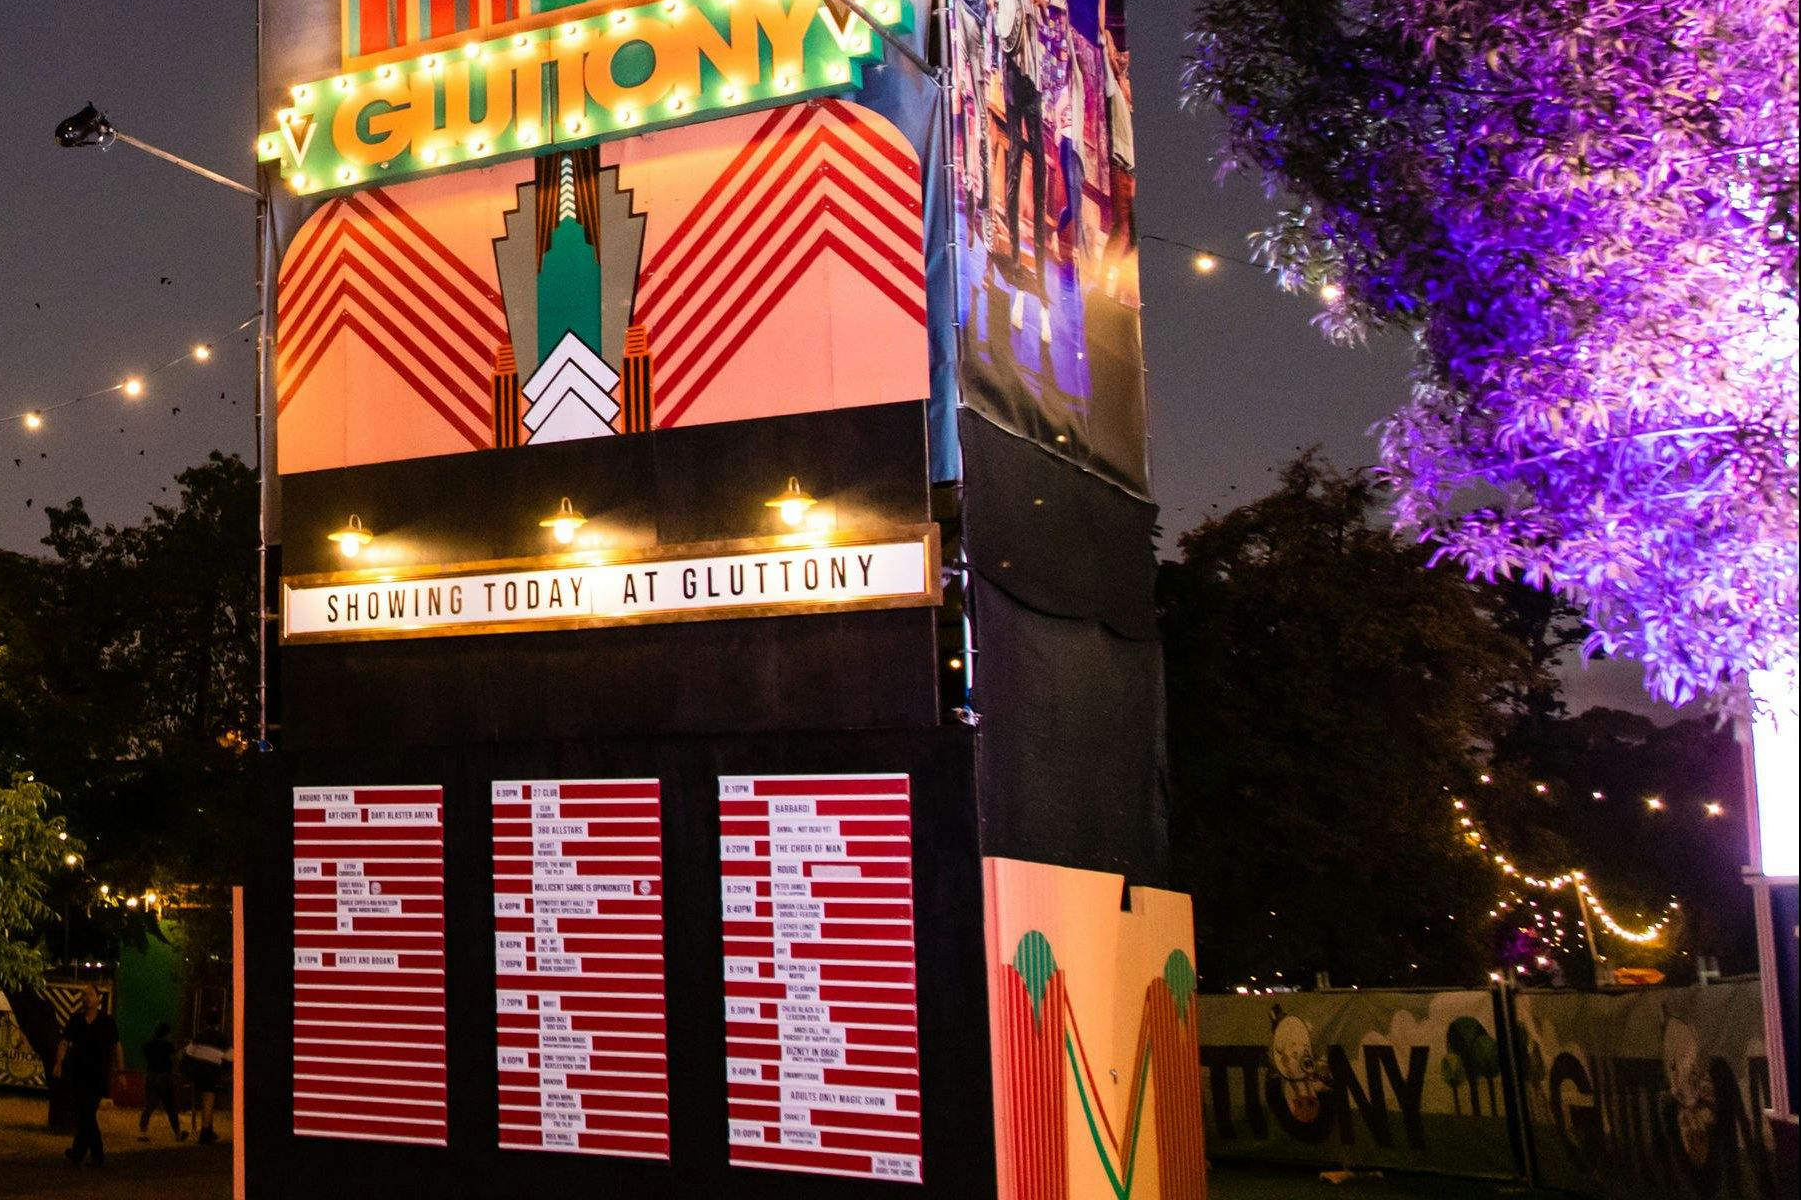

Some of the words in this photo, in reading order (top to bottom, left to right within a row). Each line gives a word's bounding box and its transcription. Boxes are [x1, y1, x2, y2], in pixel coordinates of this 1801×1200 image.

[327, 585, 464, 624] SHOWING
[485, 576, 585, 612] TODAY
[623, 571, 660, 605] AT
[683, 553, 875, 599] GLUTTONY
[532, 788, 542, 798] 27
[542, 788, 558, 798] CLUB
[551, 826, 584, 835] ALLSTARS
[774, 844, 789, 854] THE
[790, 844, 813, 854] CHOIR
[814, 844, 823, 854] OF
[825, 844, 842, 854] MAN
[534, 883, 564, 892] MILLICENT
[790, 1091, 818, 1102] ADULTS
[818, 1093, 837, 1103] ONLY
[839, 1094, 862, 1105] MAGIC
[864, 1095, 886, 1106] SHOW
